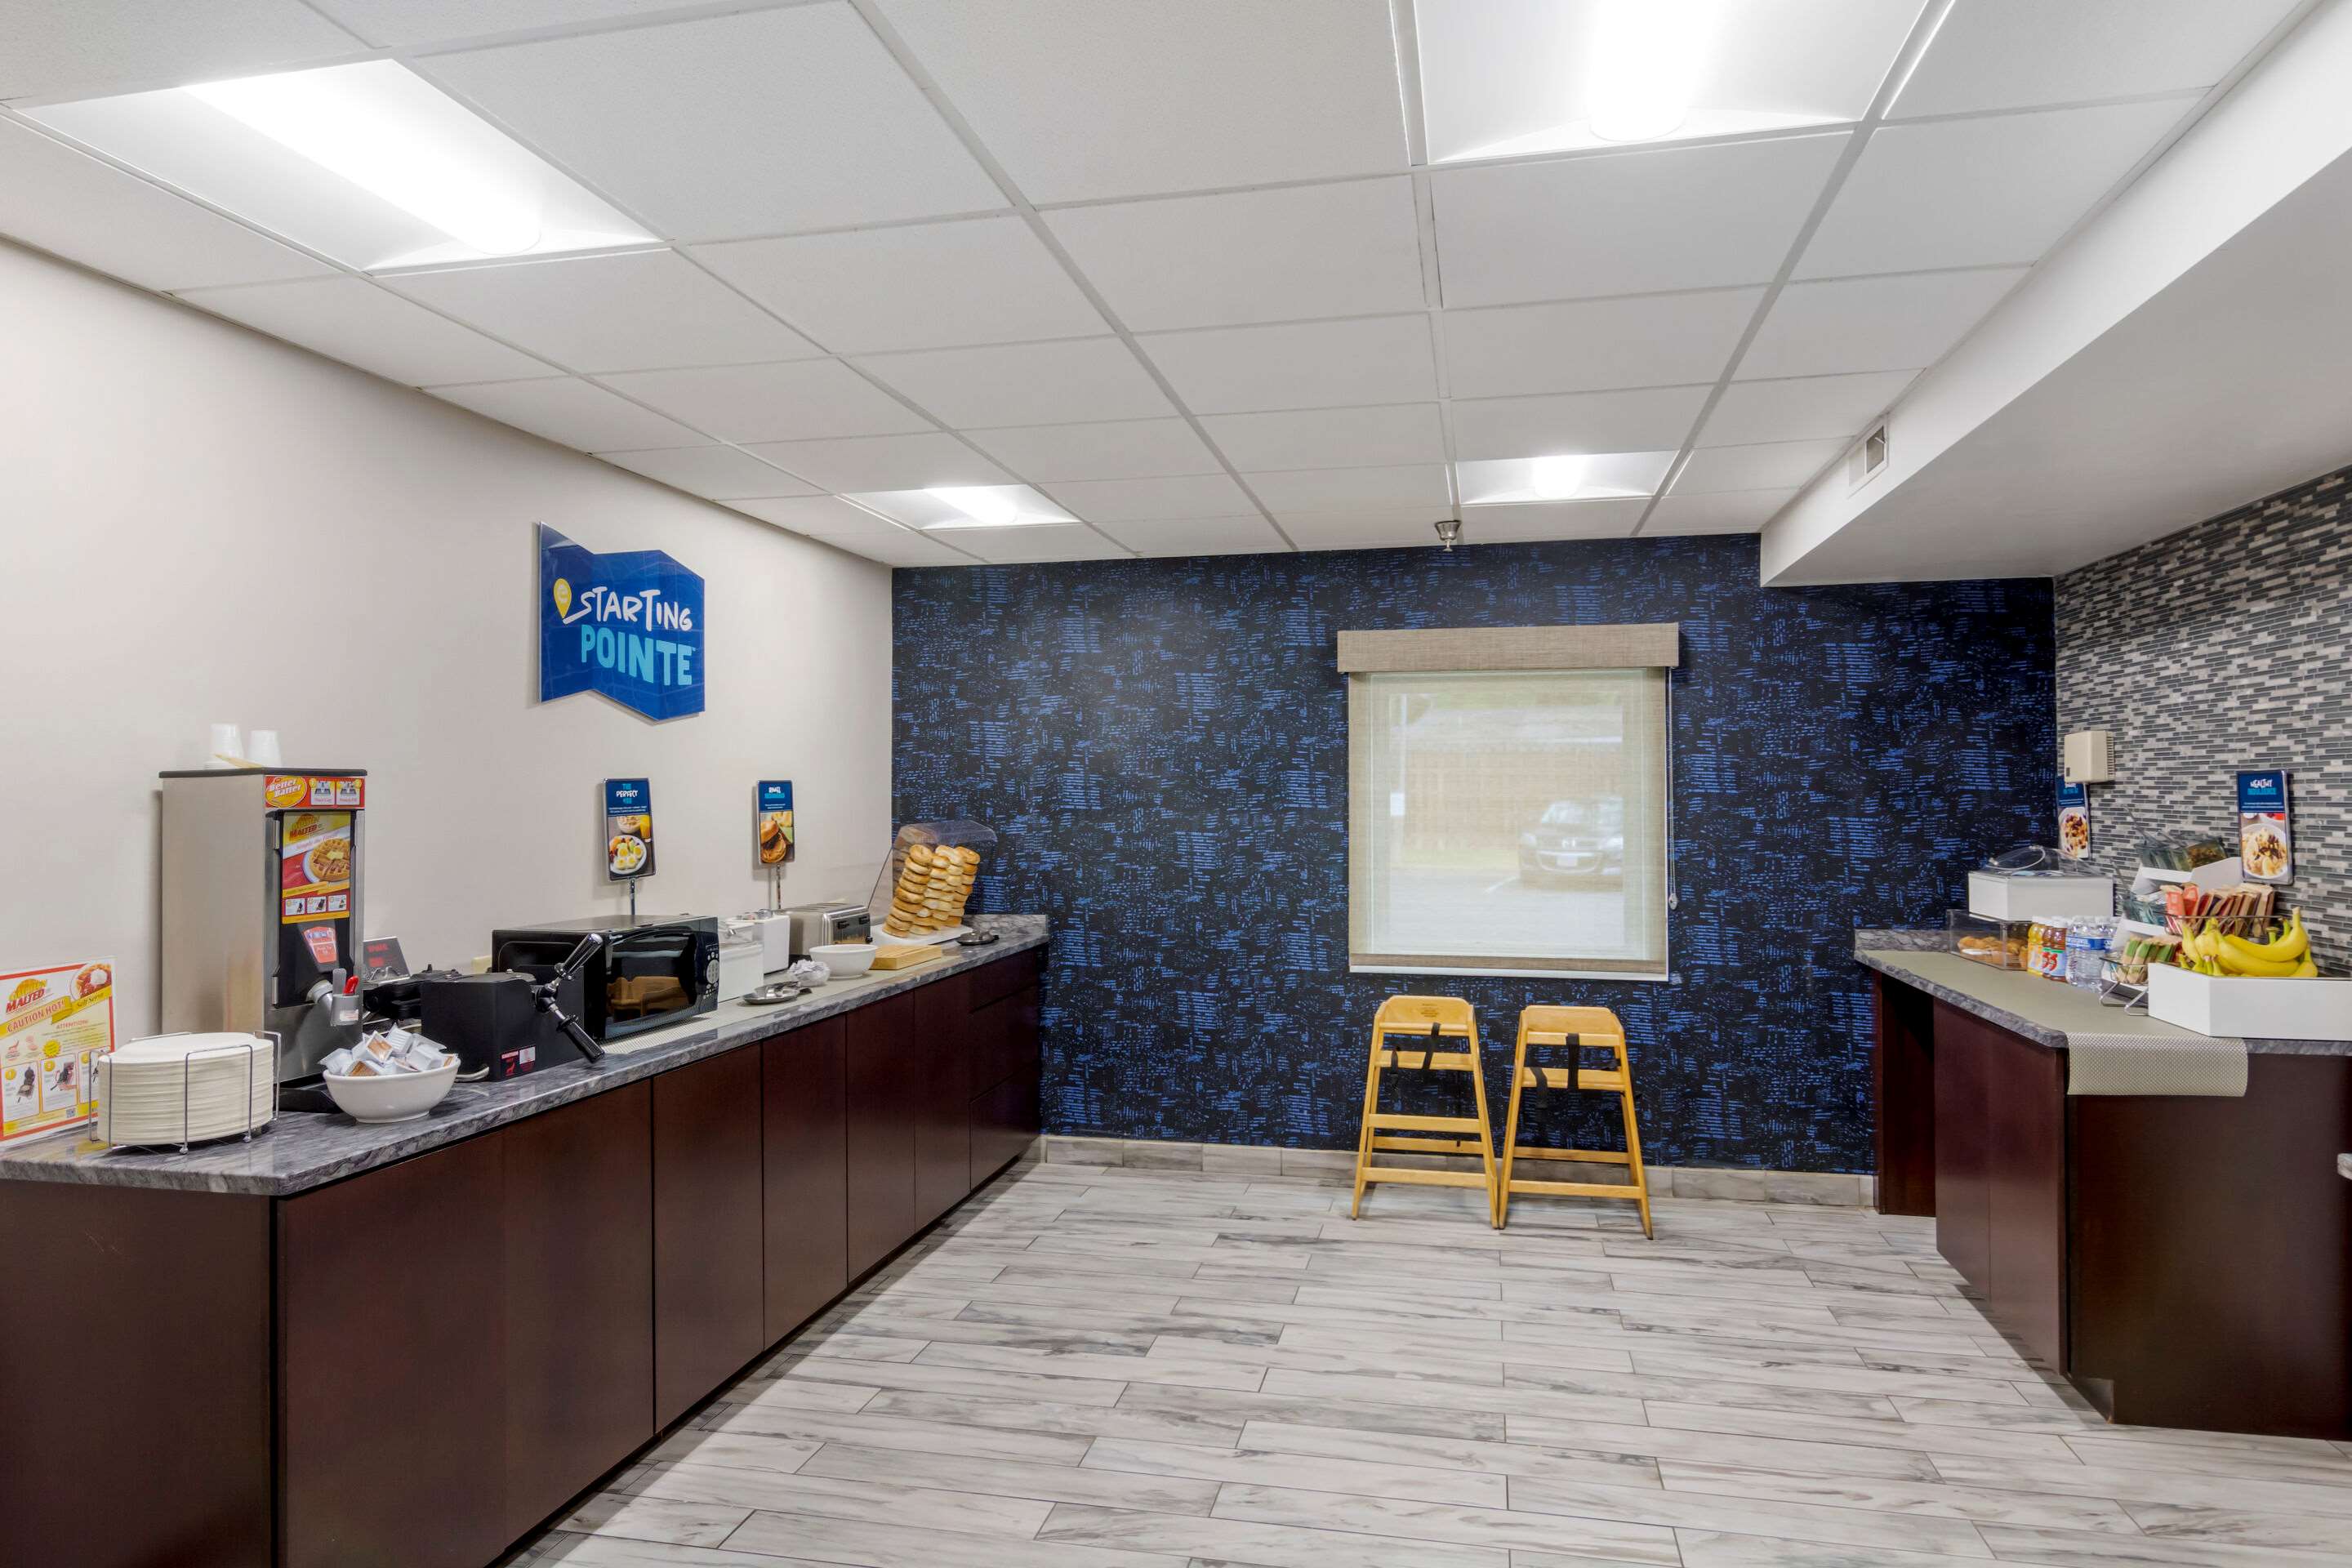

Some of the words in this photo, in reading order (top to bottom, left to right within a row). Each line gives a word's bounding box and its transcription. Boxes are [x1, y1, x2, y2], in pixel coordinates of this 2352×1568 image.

[563, 586, 693, 632] STARTING
[581, 624, 693, 686] POINTE
[616, 790, 639, 798] PERFECT
[2250, 778, 2273, 788] HEALTHY
[289, 823, 318, 838] MALTED
[6, 988, 45, 1013] MALTED
[7, 1010, 44, 1033] CAUTION
[46, 999, 65, 1015] HOT!
